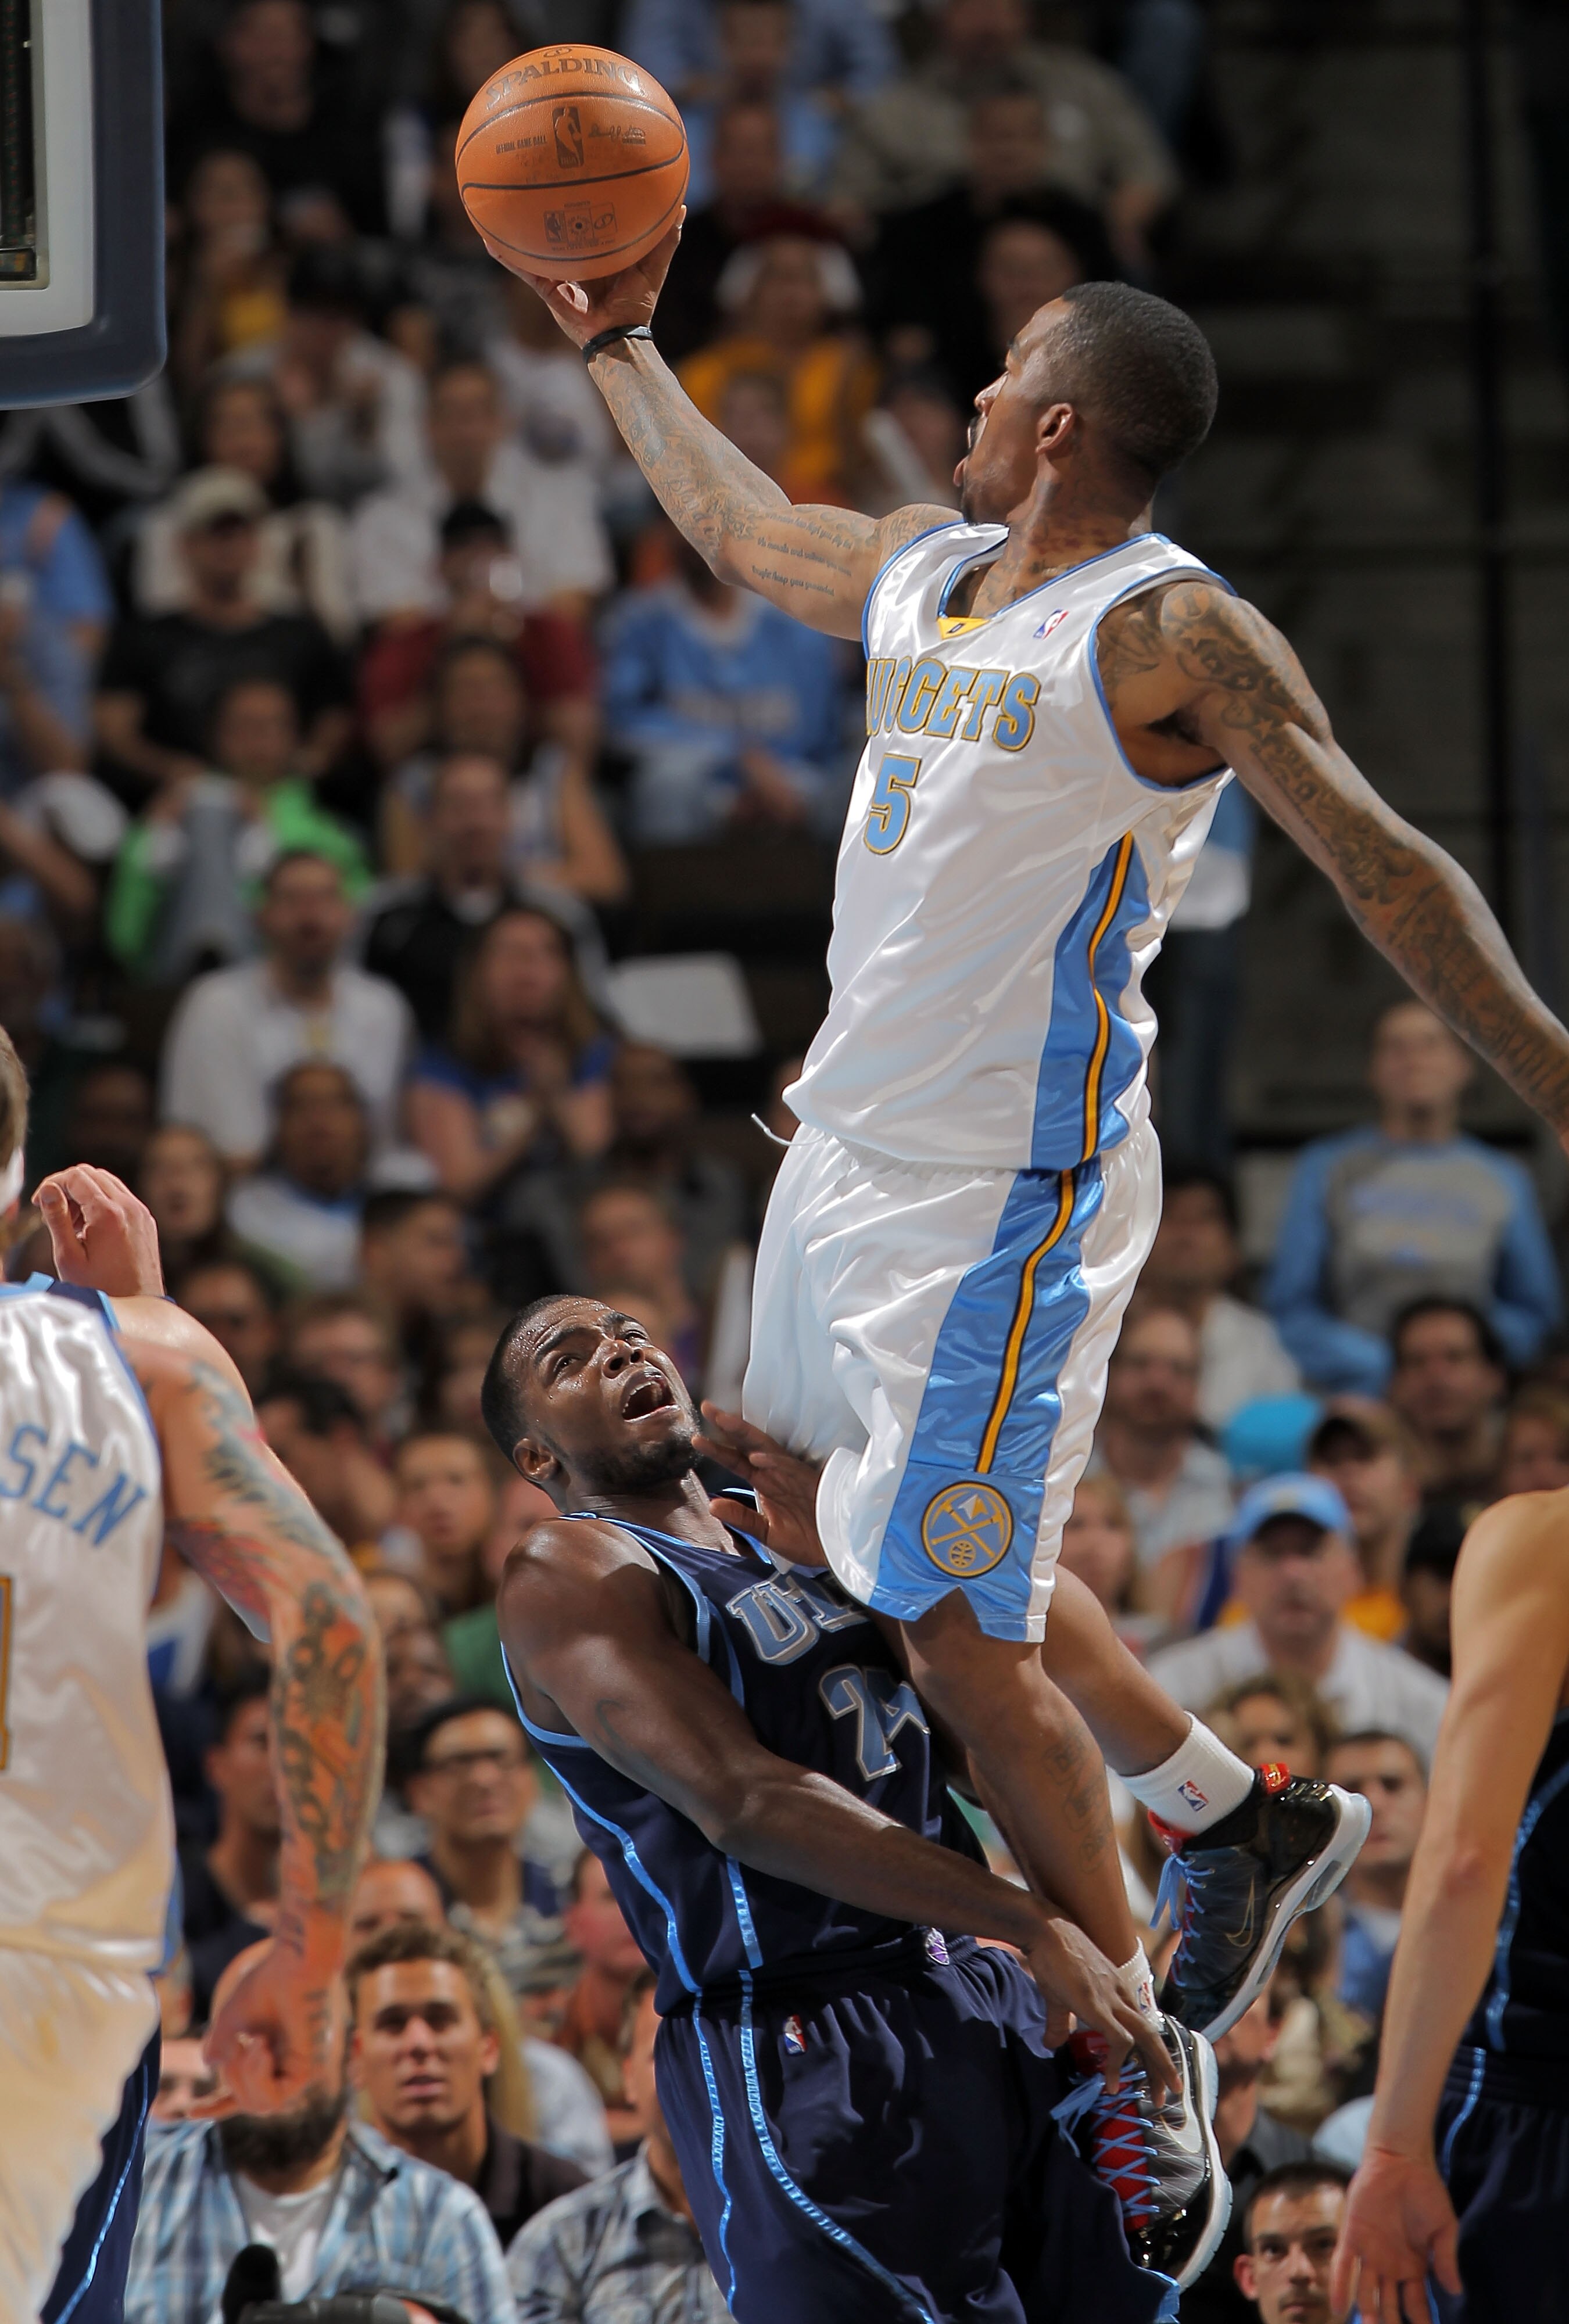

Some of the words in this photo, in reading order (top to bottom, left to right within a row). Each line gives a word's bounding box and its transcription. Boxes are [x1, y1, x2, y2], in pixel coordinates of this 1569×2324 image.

[486, 58, 642, 110] SPALDING
[517, 137, 532, 149] GAME
[533, 135, 547, 146] BALL
[864, 753, 922, 854] 5
